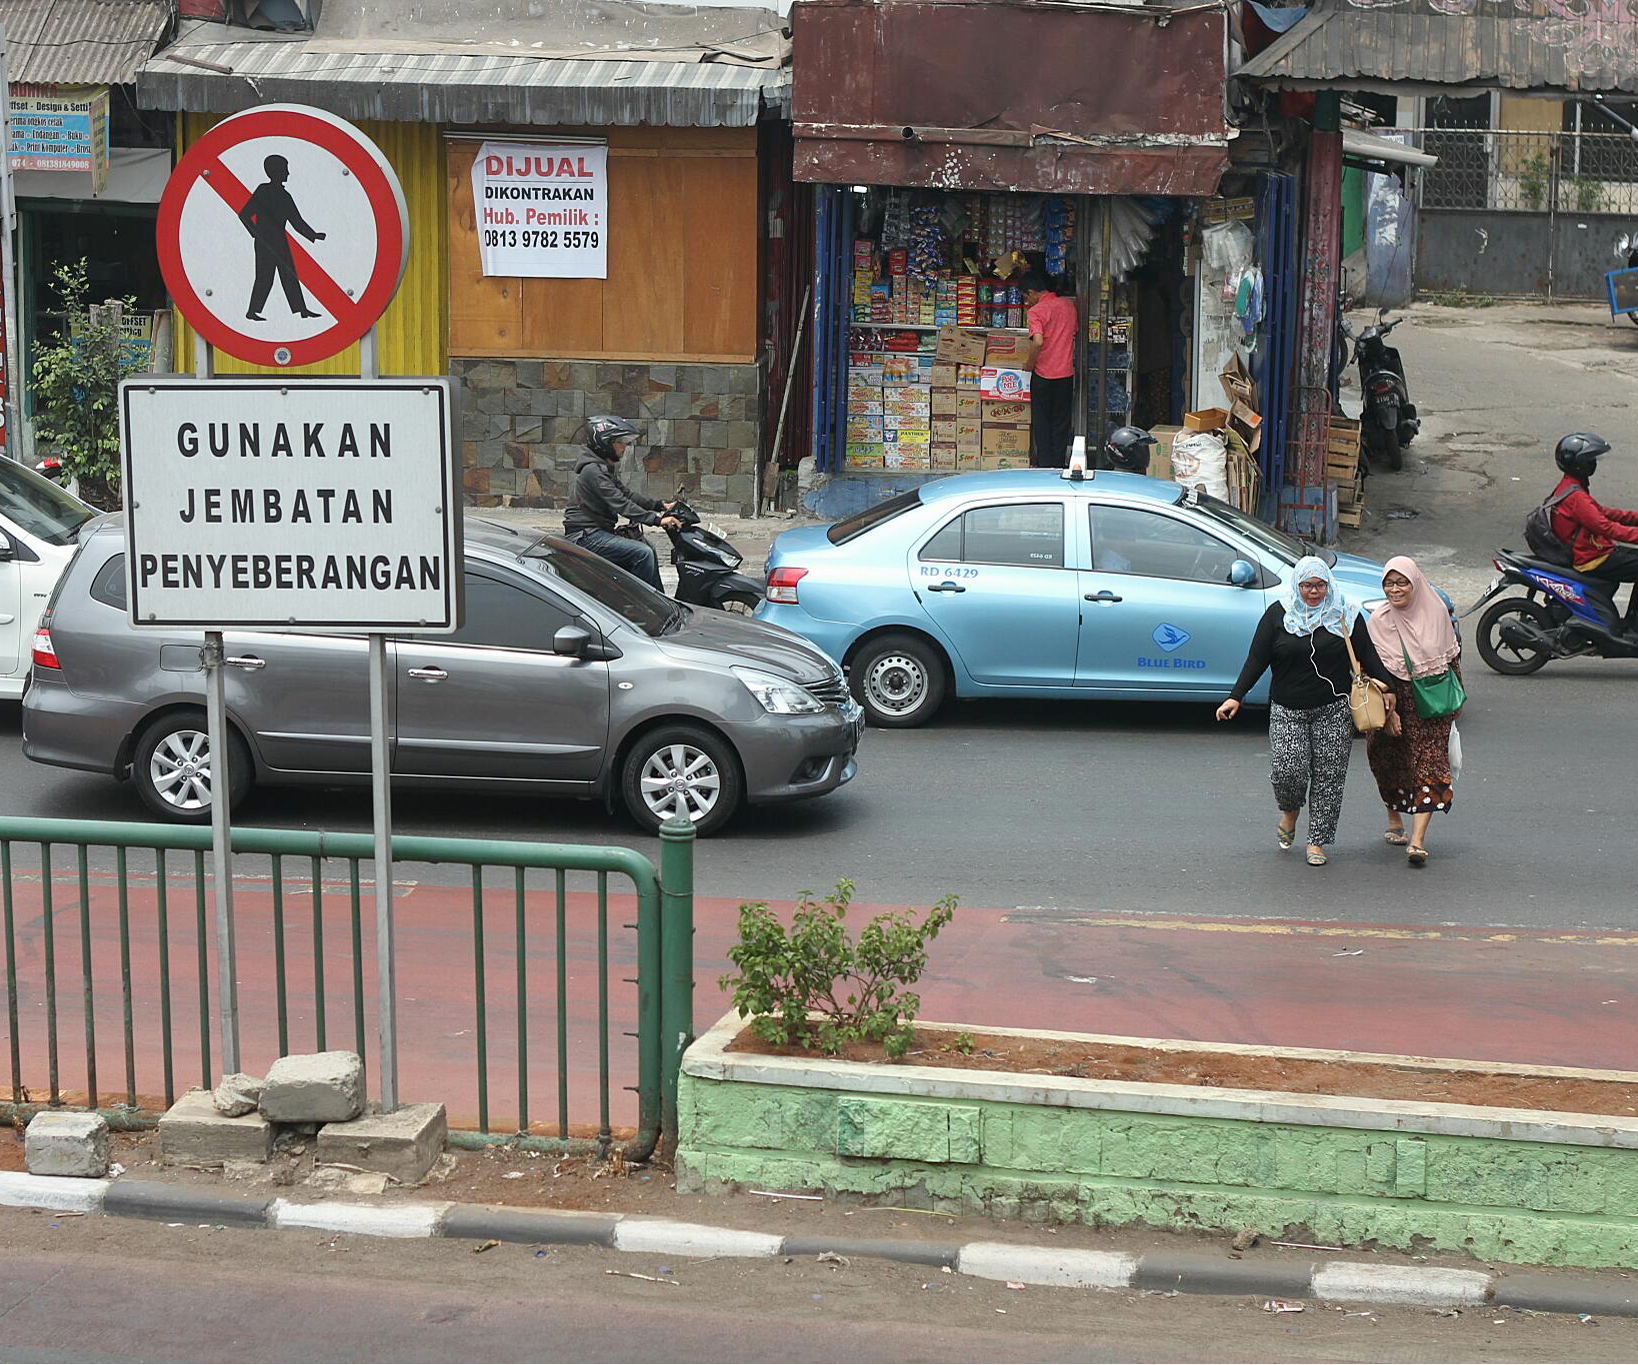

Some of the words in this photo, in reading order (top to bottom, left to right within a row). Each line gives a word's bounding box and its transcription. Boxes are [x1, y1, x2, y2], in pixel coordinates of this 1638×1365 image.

[10, 101, 28, 110] ffset
[36, 102, 62, 112] Design
[64, 103, 69, 111] &
[48, 118, 63, 127] cetak
[11, 130, 25, 138] ama
[67, 131, 83, 140] Buku
[26, 142, 40, 152] Print
[485, 155, 594, 177] DIJUAL
[485, 186, 594, 200] DIKONTRAKAN
[484, 207, 520, 225] Hub.
[526, 208, 589, 225] Pemilik
[484, 230, 517, 247] 0813
[522, 231, 558, 248] 9782
[563, 231, 599, 248] 5579
[121, 316, 146, 326] OFFSET
[177, 422, 391, 458] GUNAKAN
[179, 489, 393, 524] JEMBATAN
[140, 554, 440, 590] PENYEBERANGAN
[920, 566, 940, 576] RD
[944, 567, 979, 578] 6429
